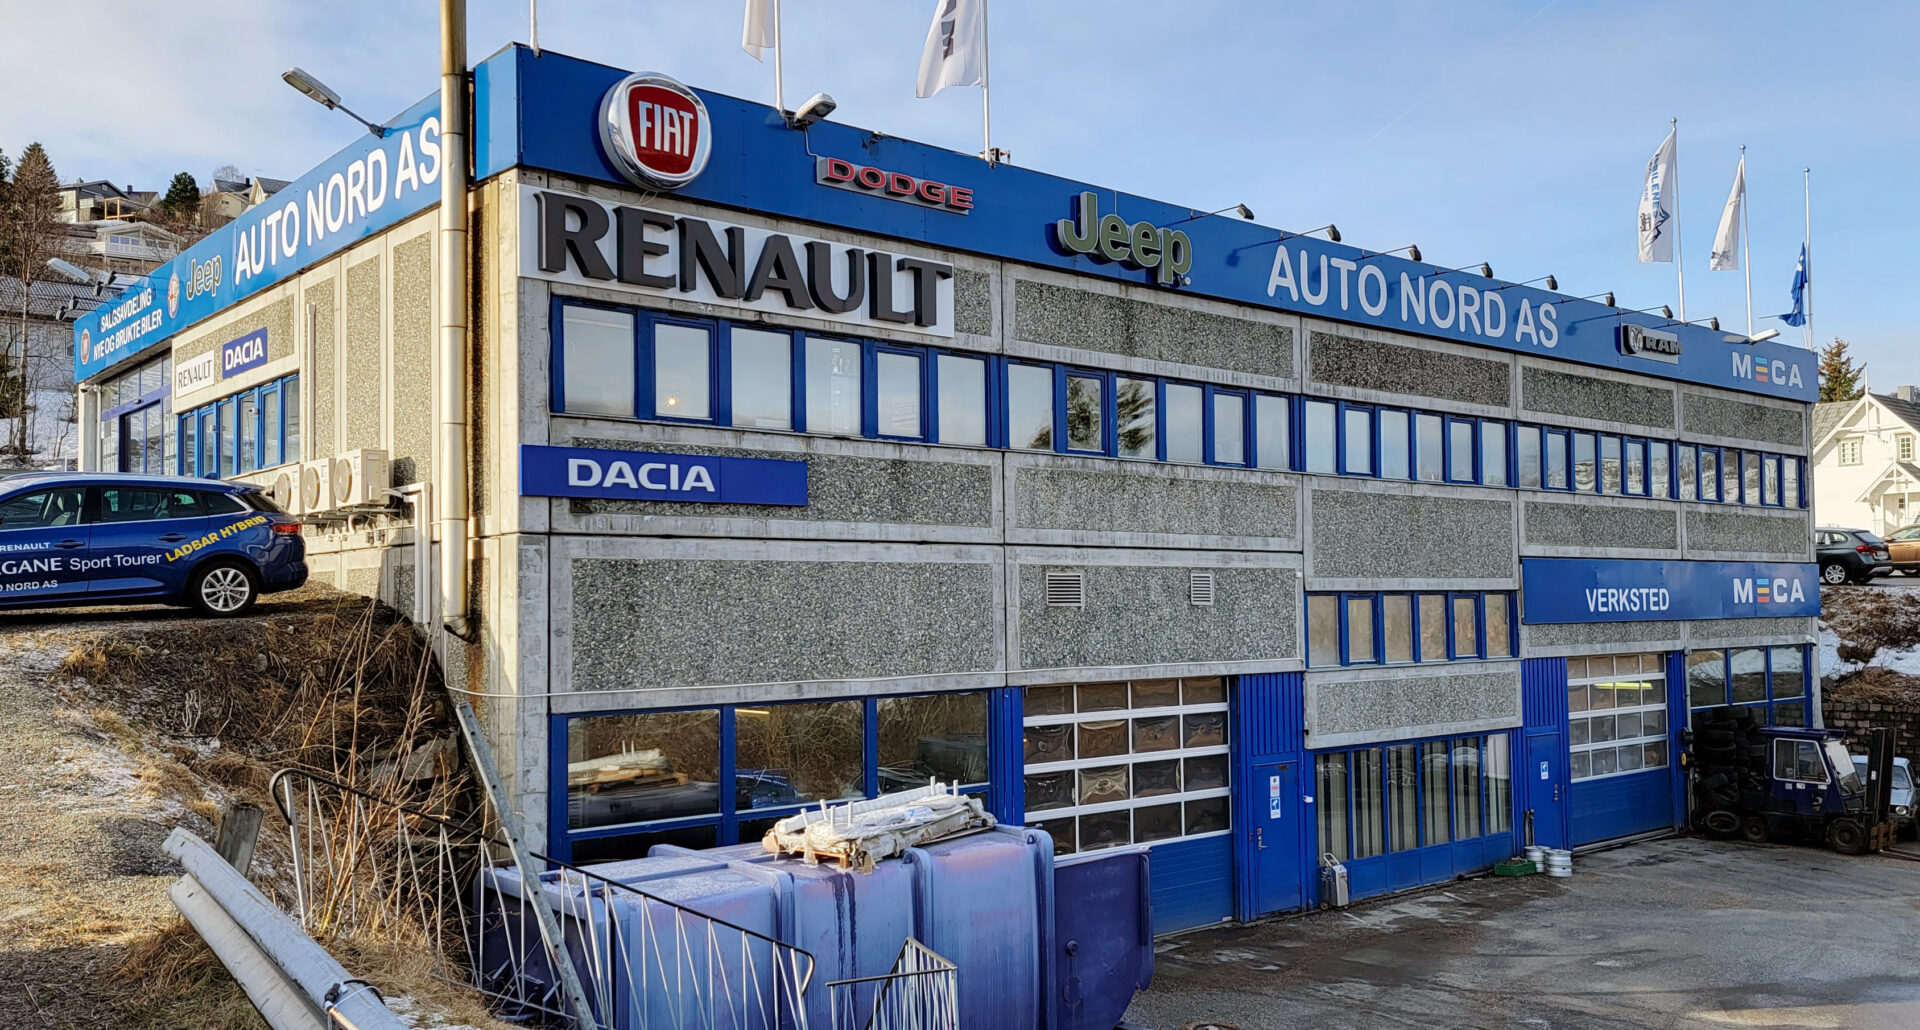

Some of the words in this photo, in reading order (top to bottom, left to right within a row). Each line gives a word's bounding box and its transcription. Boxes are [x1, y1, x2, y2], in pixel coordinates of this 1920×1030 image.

[638, 101, 695, 157] FIAT
[235, 201, 300, 286] AUTO
[306, 148, 388, 247] NORD
[394, 116, 441, 200] AS
[823, 156, 975, 210] DODGE
[1057, 190, 1193, 286] Jeep
[186, 255, 223, 301] Jeep
[534, 190, 954, 328] RENAULT
[101, 288, 152, 333] SALGSAVDELING
[1266, 245, 1389, 318] AUTO
[1401, 271, 1508, 339] NORD
[1514, 297, 1559, 349] AS
[93, 340, 105, 361] NYE
[105, 334, 115, 354] OG
[116, 319, 141, 349] BRUKTE
[141, 308, 162, 335] BILER
[225, 337, 264, 371] DACIA
[1643, 335, 1683, 355] RAM
[177, 359, 212, 390] RENAULT
[1731, 351, 1804, 389] MECA
[567, 458, 716, 493] DACIA
[0, 542, 51, 552] RENAULT
[165, 532, 220, 562] LADBAR
[219, 515, 268, 539] HYBRID
[0, 557, 63, 576] GANE
[69, 556, 112, 572] Sport
[113, 554, 163, 567] Tourer
[5, 581, 40, 592] NORD
[42, 579, 58, 589] AS
[1585, 587, 1670, 613] VERKSTED
[1732, 578, 1805, 604] MECA
